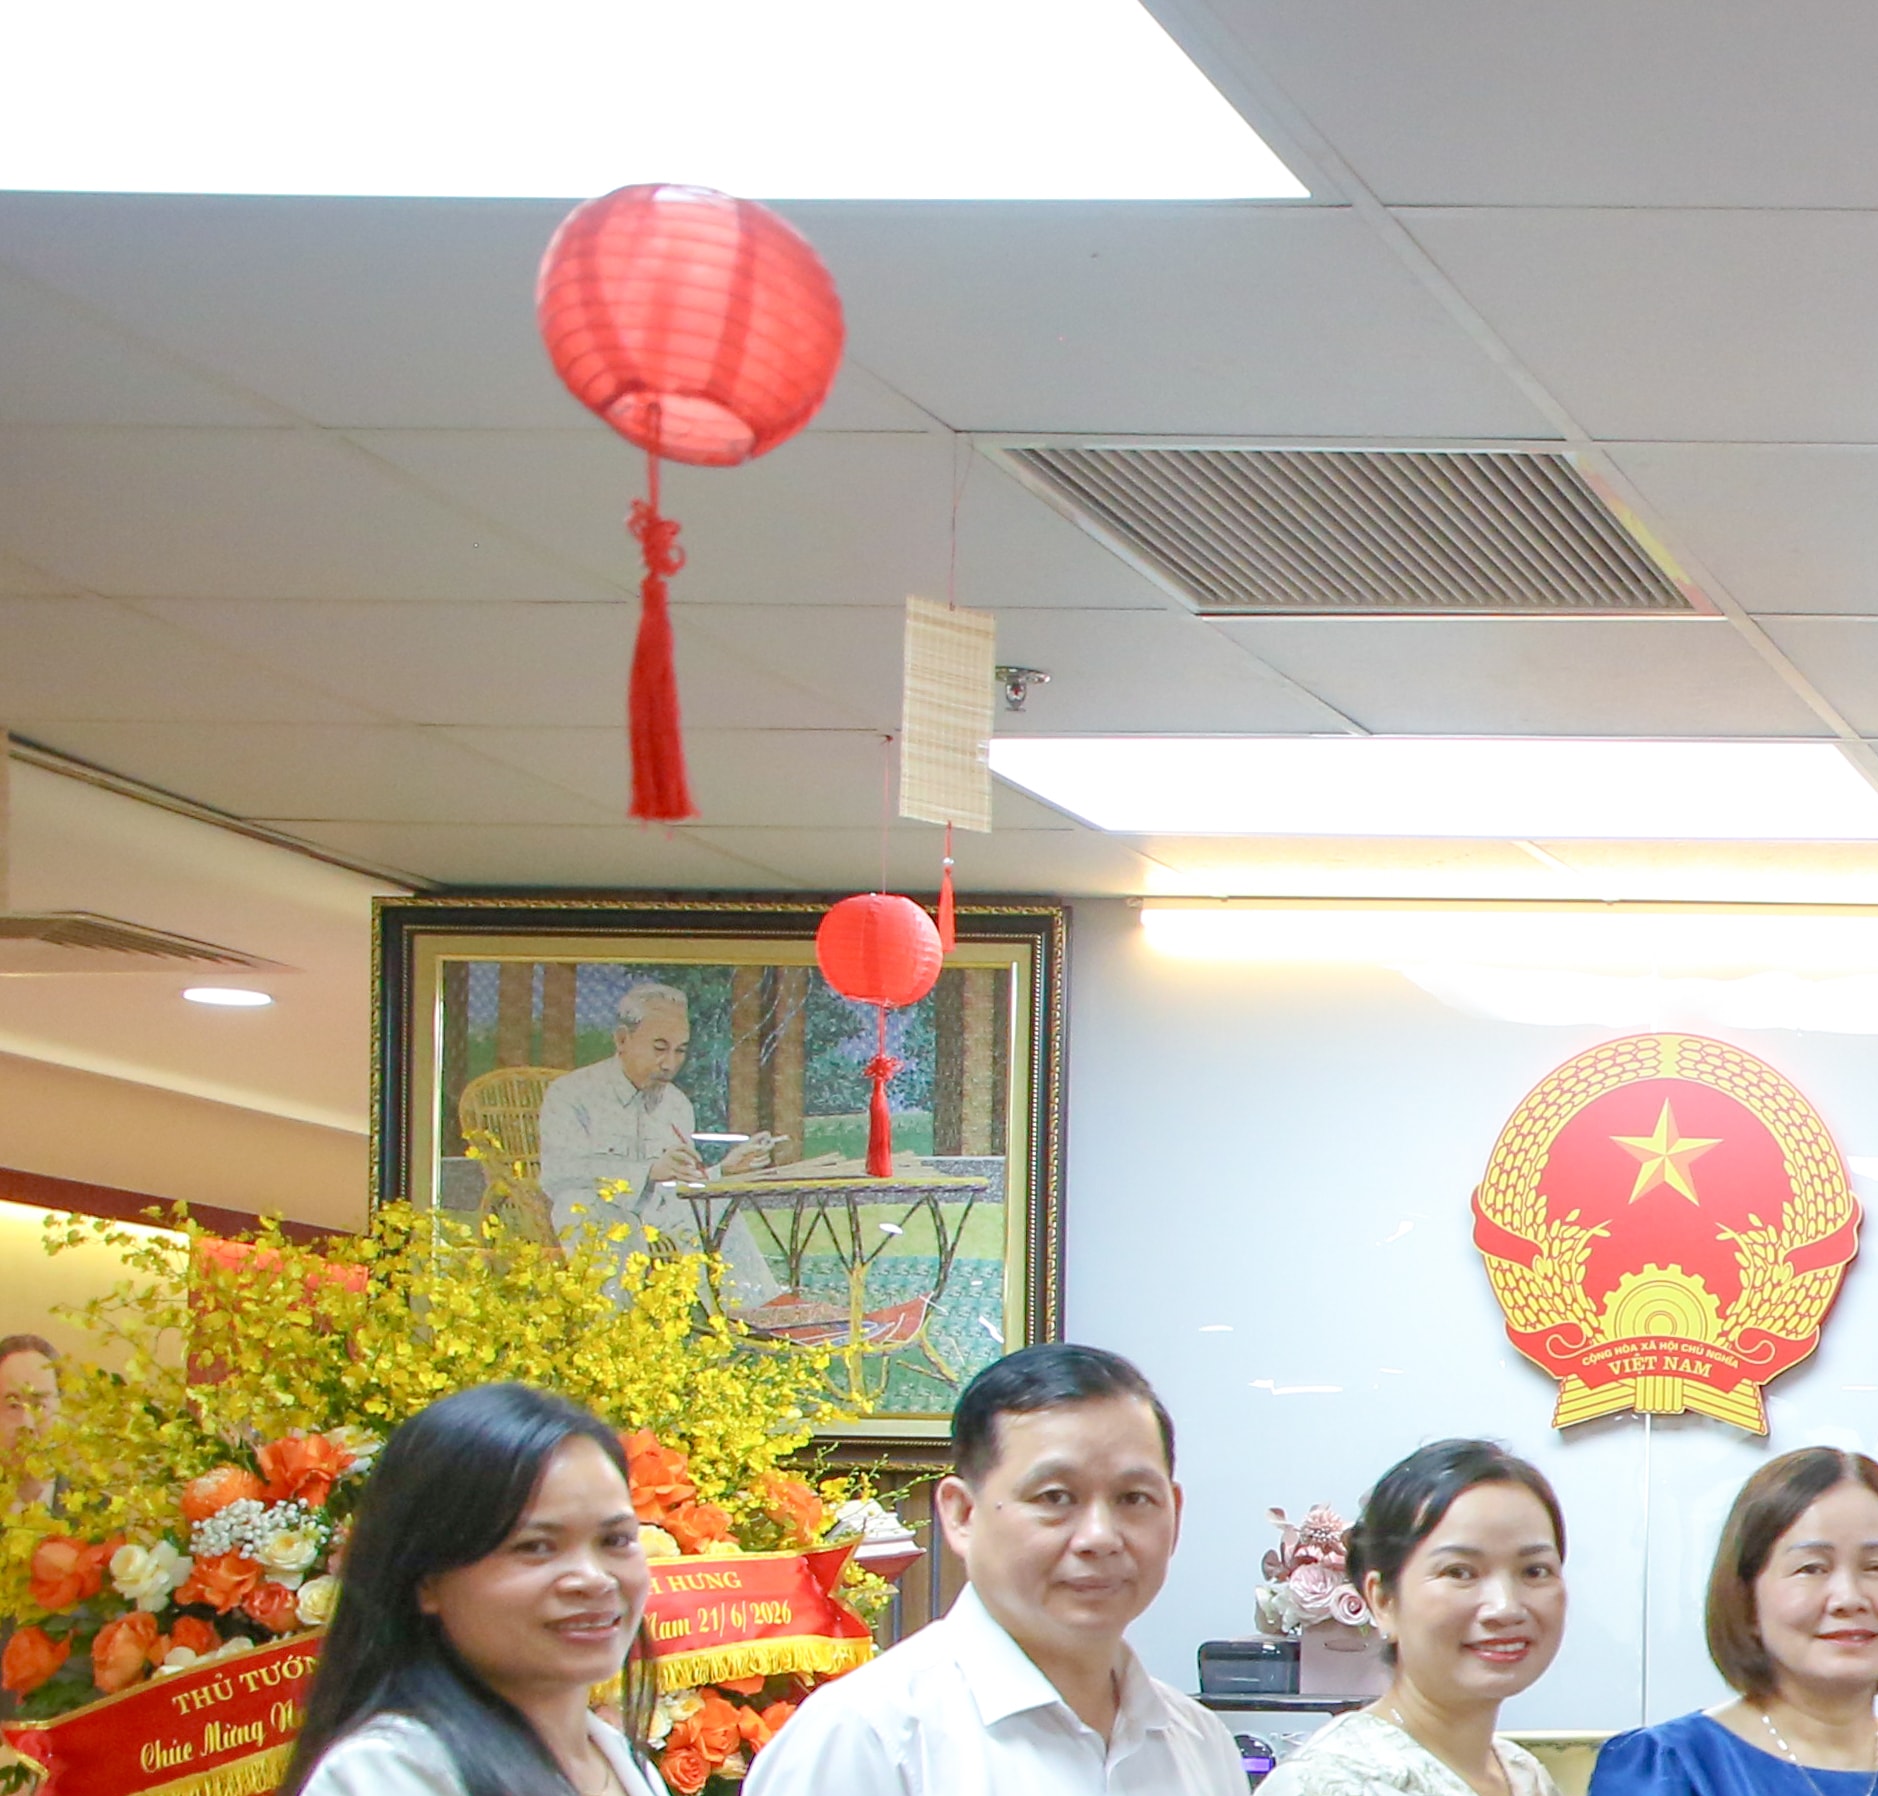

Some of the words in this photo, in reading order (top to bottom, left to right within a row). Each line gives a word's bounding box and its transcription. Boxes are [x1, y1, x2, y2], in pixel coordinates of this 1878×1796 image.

[1582, 1348, 1613, 1366] CỘNG
[1614, 1343, 1639, 1356] HÒA
[1640, 1340, 1657, 1351] XÃ
[1659, 1341, 1679, 1353] HỘI
[1681, 1343, 1704, 1355] CHỦ
[1705, 1349, 1739, 1368] NGHĨA
[1607, 1353, 1658, 1375] VIỆT
[1663, 1355, 1713, 1378] NAM
[664, 1571, 743, 1594] HƯNG
[172, 1672, 234, 1715] THỦ
[140, 1739, 193, 1773] Chúc
